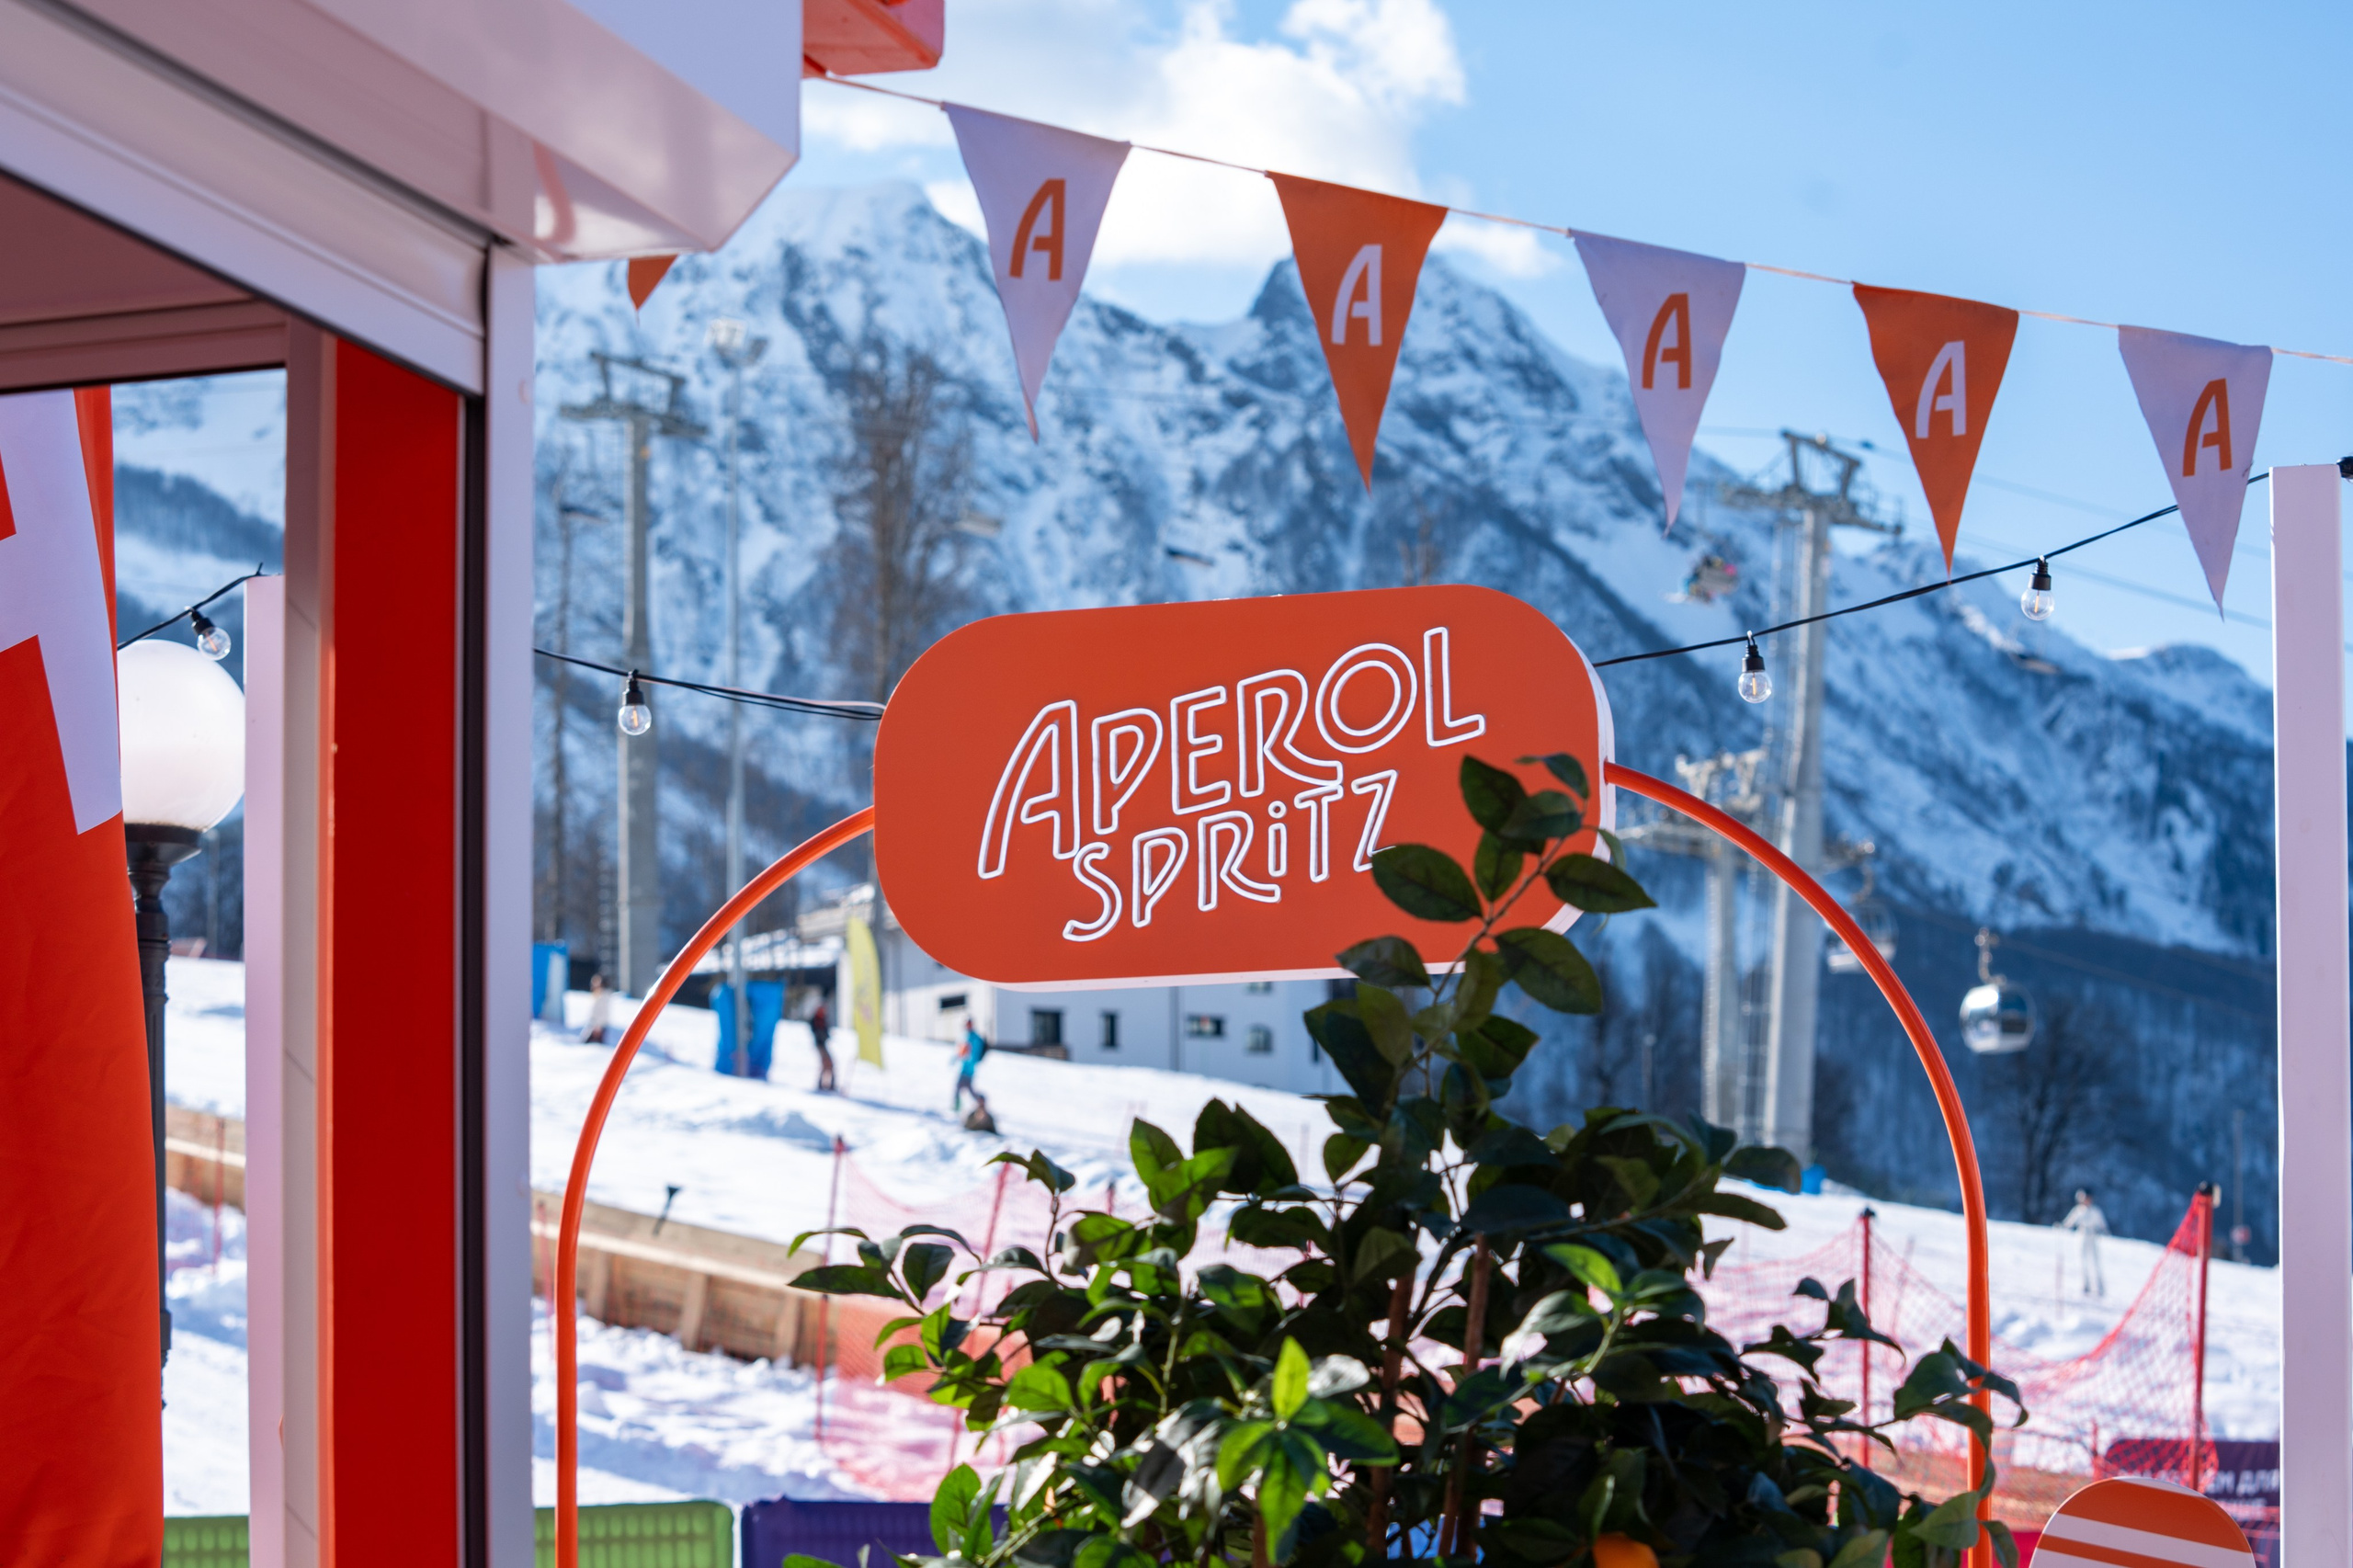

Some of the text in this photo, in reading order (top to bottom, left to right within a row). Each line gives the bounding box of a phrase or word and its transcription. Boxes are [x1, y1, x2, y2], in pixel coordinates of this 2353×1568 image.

[1009, 178, 1066, 281] A
[1331, 244, 1382, 346] A
[1641, 292, 1691, 391] A
[1915, 340, 1966, 439] A
[2182, 378, 2232, 477] A
[977, 626, 1486, 879] APEROL
